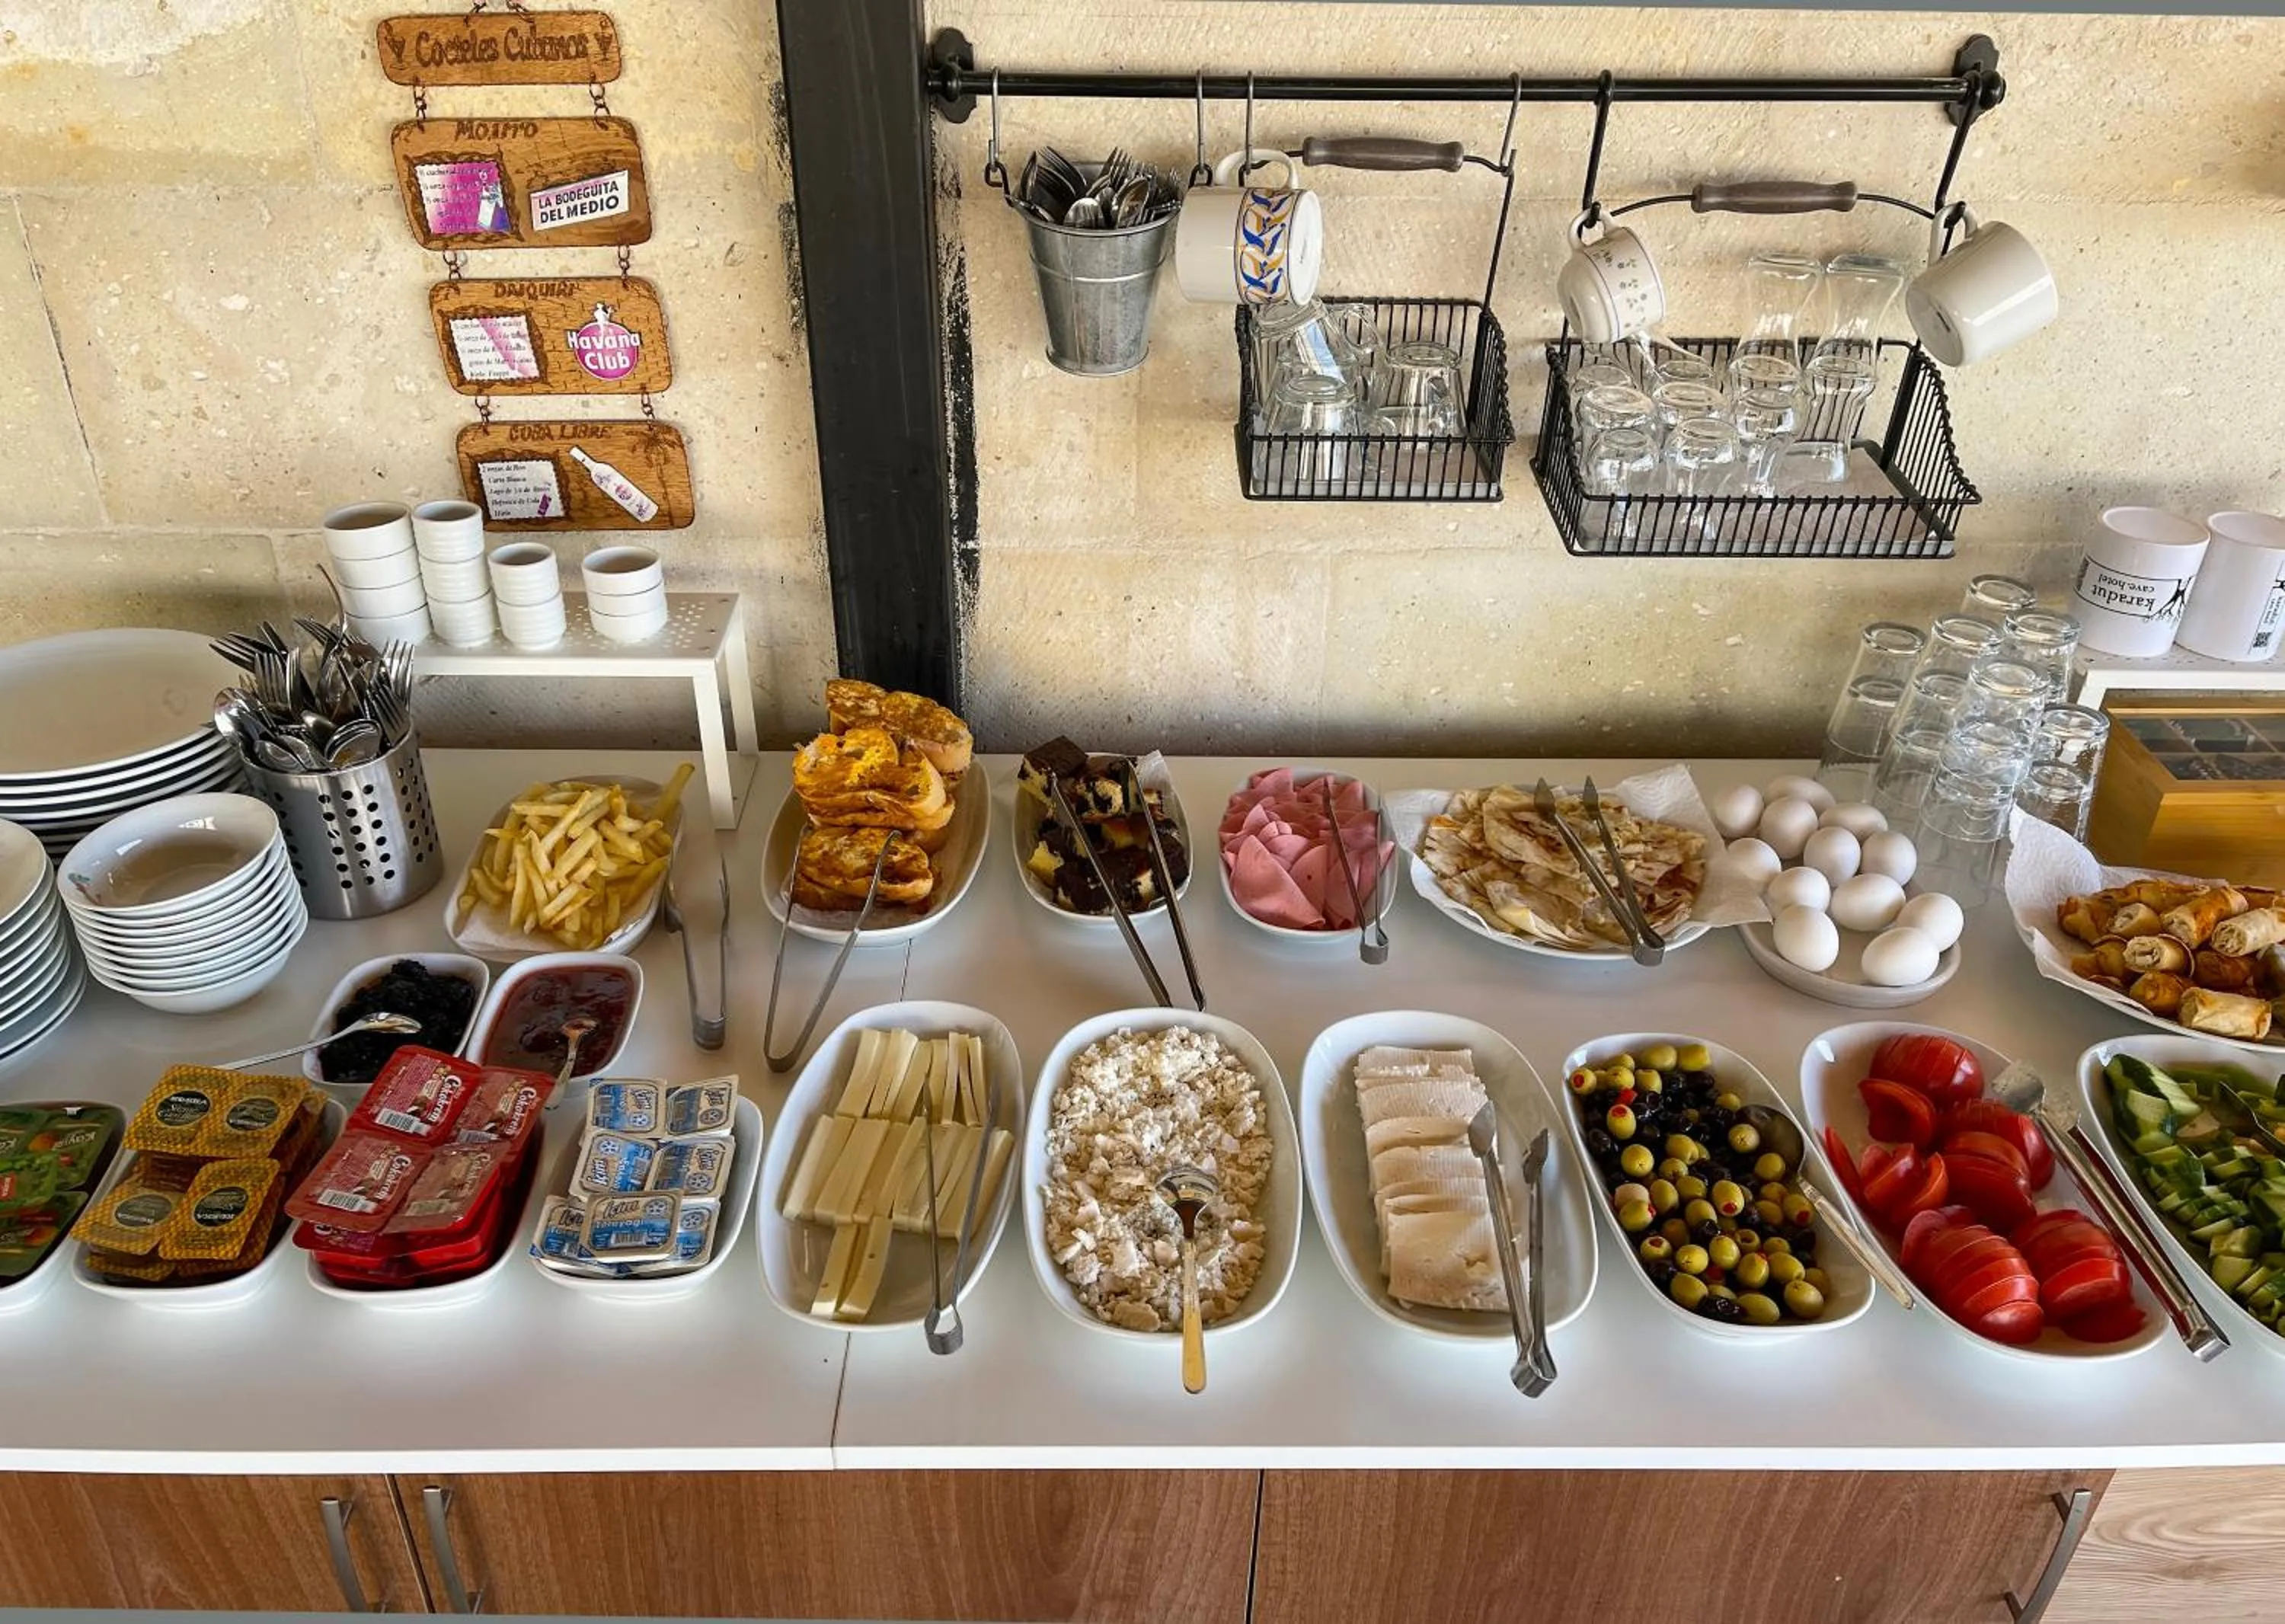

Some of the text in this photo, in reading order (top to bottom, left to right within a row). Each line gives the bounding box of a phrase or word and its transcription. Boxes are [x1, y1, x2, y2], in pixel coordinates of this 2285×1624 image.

[504, 25, 590, 62] Cubanos
[538, 181, 619, 209] LA BODEGUITA
[540, 195, 620, 224] DEL MEDIO
[567, 330, 641, 350] Havana
[584, 351, 631, 370] Club
[509, 424, 612, 440] CUBA LIBRE
[2092, 584, 2156, 612] karadut
